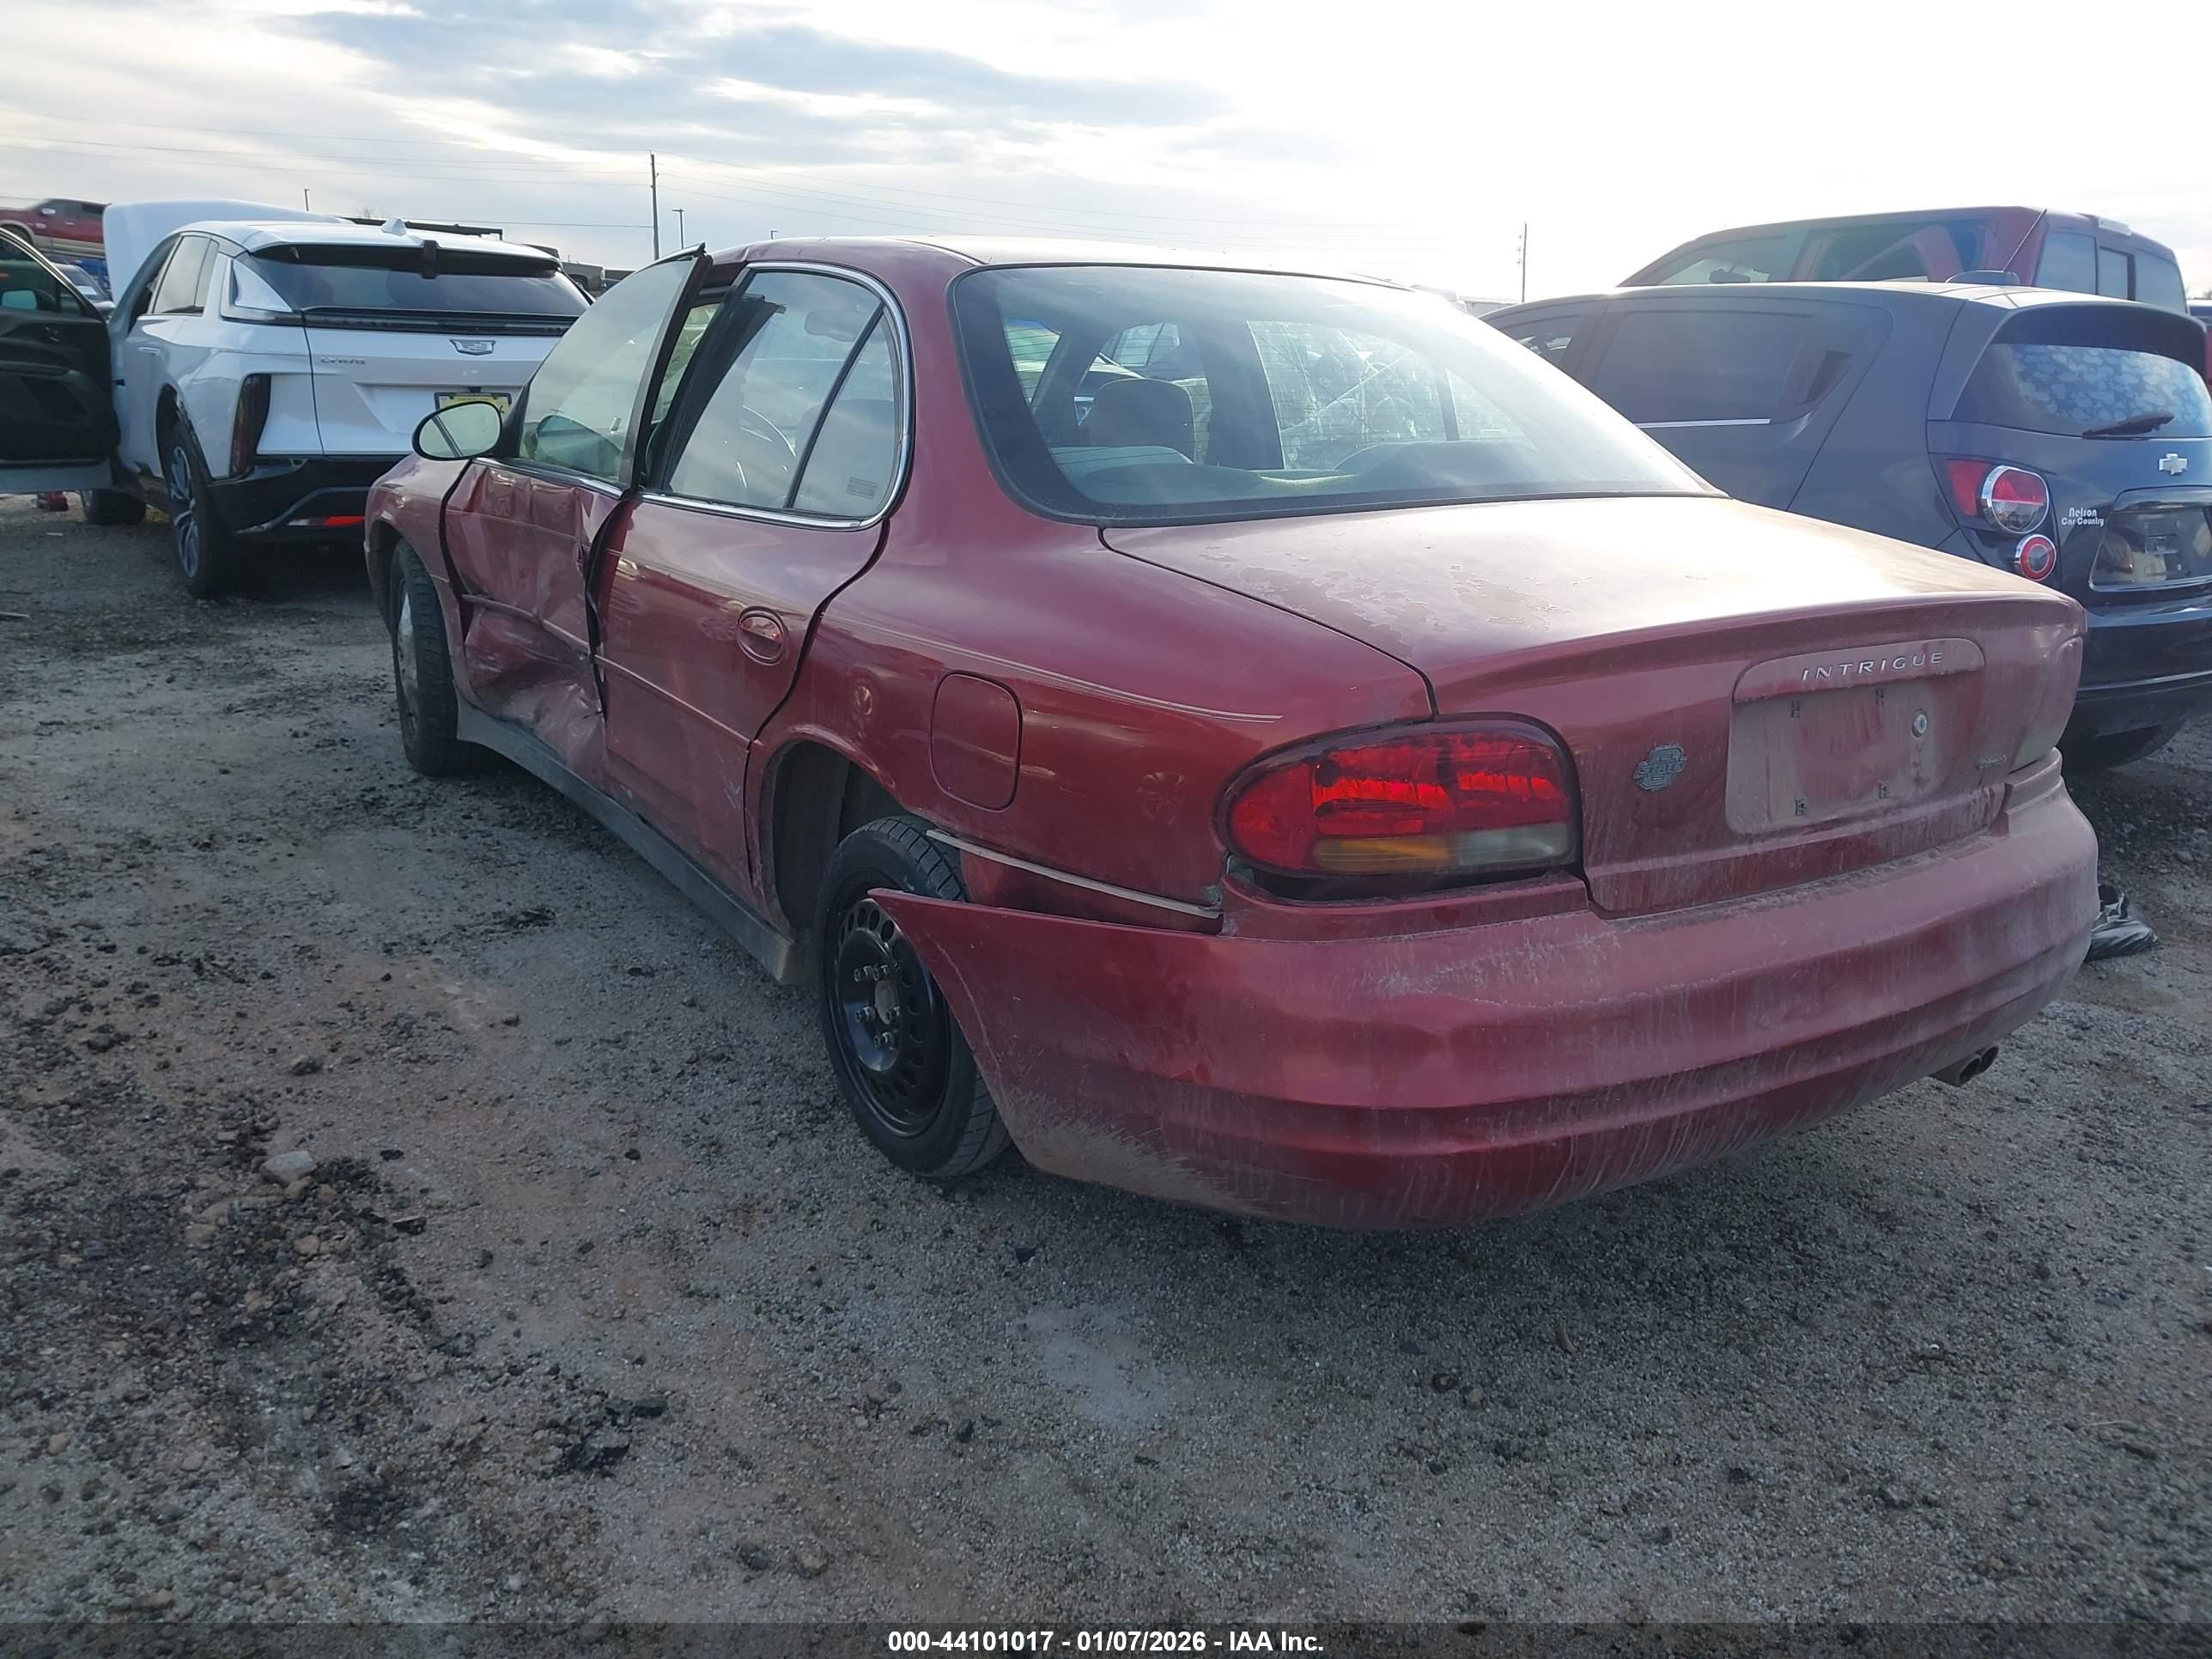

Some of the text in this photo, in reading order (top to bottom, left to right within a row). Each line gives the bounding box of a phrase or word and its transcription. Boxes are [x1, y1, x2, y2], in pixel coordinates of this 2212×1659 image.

[2069, 507, 2098, 517] Nelson
[2061, 516, 2105, 527] Car Country
[1801, 652, 1944, 682] INTRIGUE
